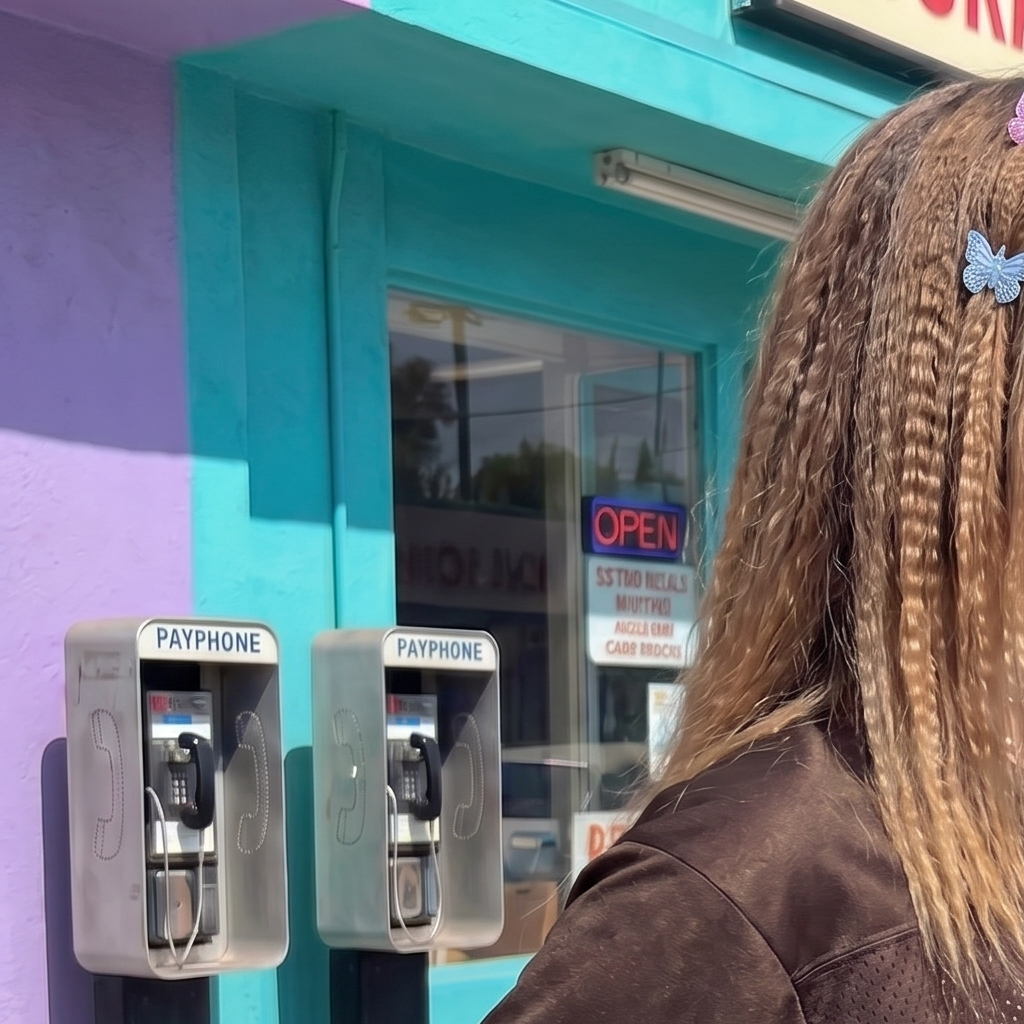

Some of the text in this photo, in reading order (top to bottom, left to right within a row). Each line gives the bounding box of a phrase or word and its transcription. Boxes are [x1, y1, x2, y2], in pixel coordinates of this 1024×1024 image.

[594, 506, 679, 551] OPEN
[156, 626, 261, 654] PAYPHONE
[397, 637, 483, 662] PAYPHONE
